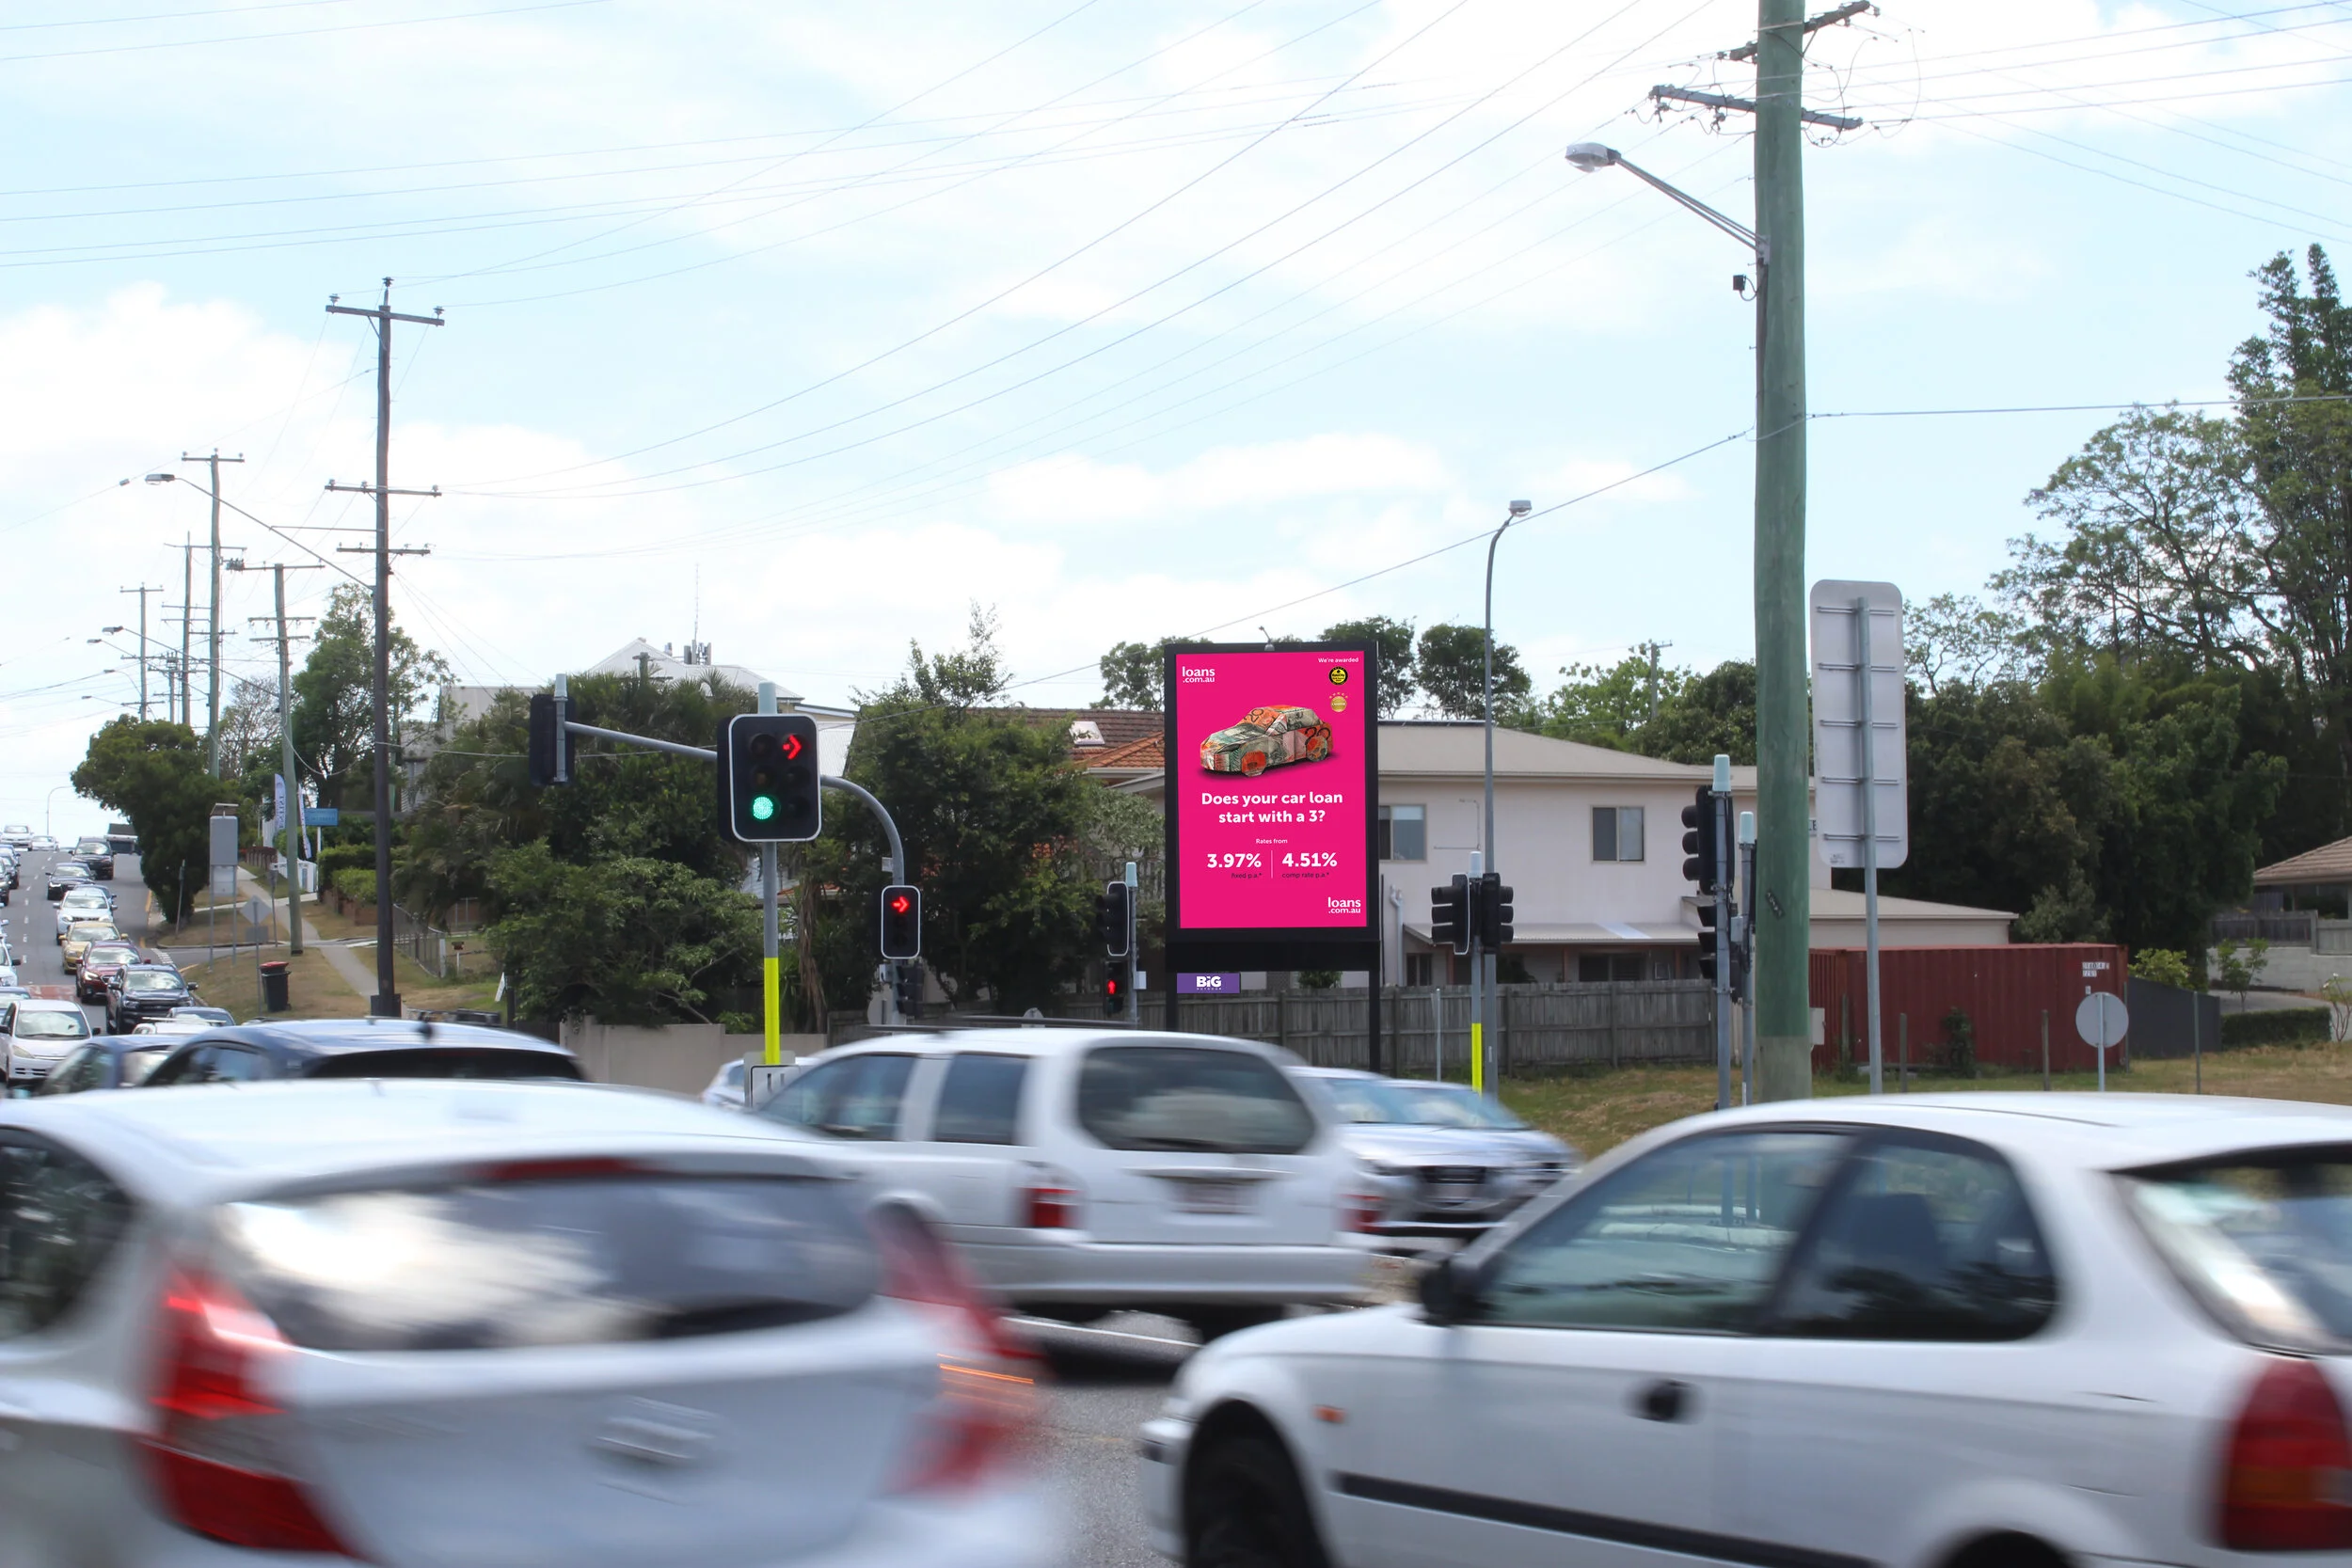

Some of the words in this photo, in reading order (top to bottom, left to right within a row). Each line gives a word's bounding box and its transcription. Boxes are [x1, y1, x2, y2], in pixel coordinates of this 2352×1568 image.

[1182, 666, 1216, 677] loans
[1201, 792, 1239, 805] Does
[1242, 794, 1278, 807] your
[1280, 794, 1306, 804] car
[1309, 791, 1343, 803] loan
[1218, 812, 1255, 823] start
[1258, 810, 1293, 823] with
[1295, 813, 1305, 823] a
[1309, 809, 1326, 823] 3?
[1206, 852, 1262, 868] 3.97%
[1281, 852, 1338, 867] 4.51%
[1327, 896, 1361, 908] loans
